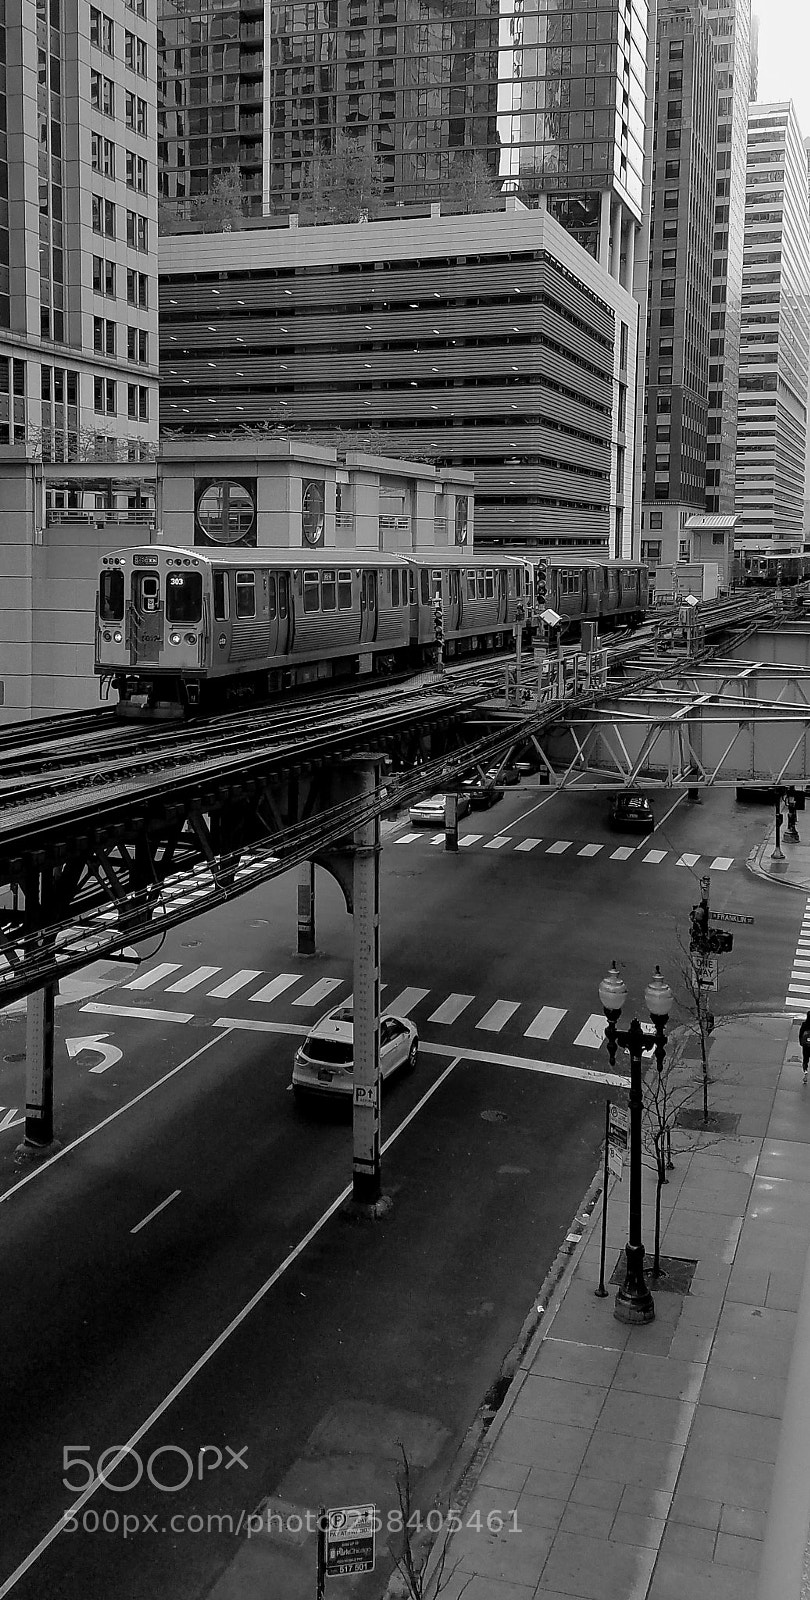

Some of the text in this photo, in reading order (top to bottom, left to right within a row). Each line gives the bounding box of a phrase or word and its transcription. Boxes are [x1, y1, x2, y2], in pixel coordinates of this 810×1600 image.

[170, 577, 184, 586] 303
[717, 913, 747, 923] FRANKLIN
[696, 958, 714, 969] ONE
[339, 1564, 353, 1573] 517
[355, 1563, 368, 1571] 501
